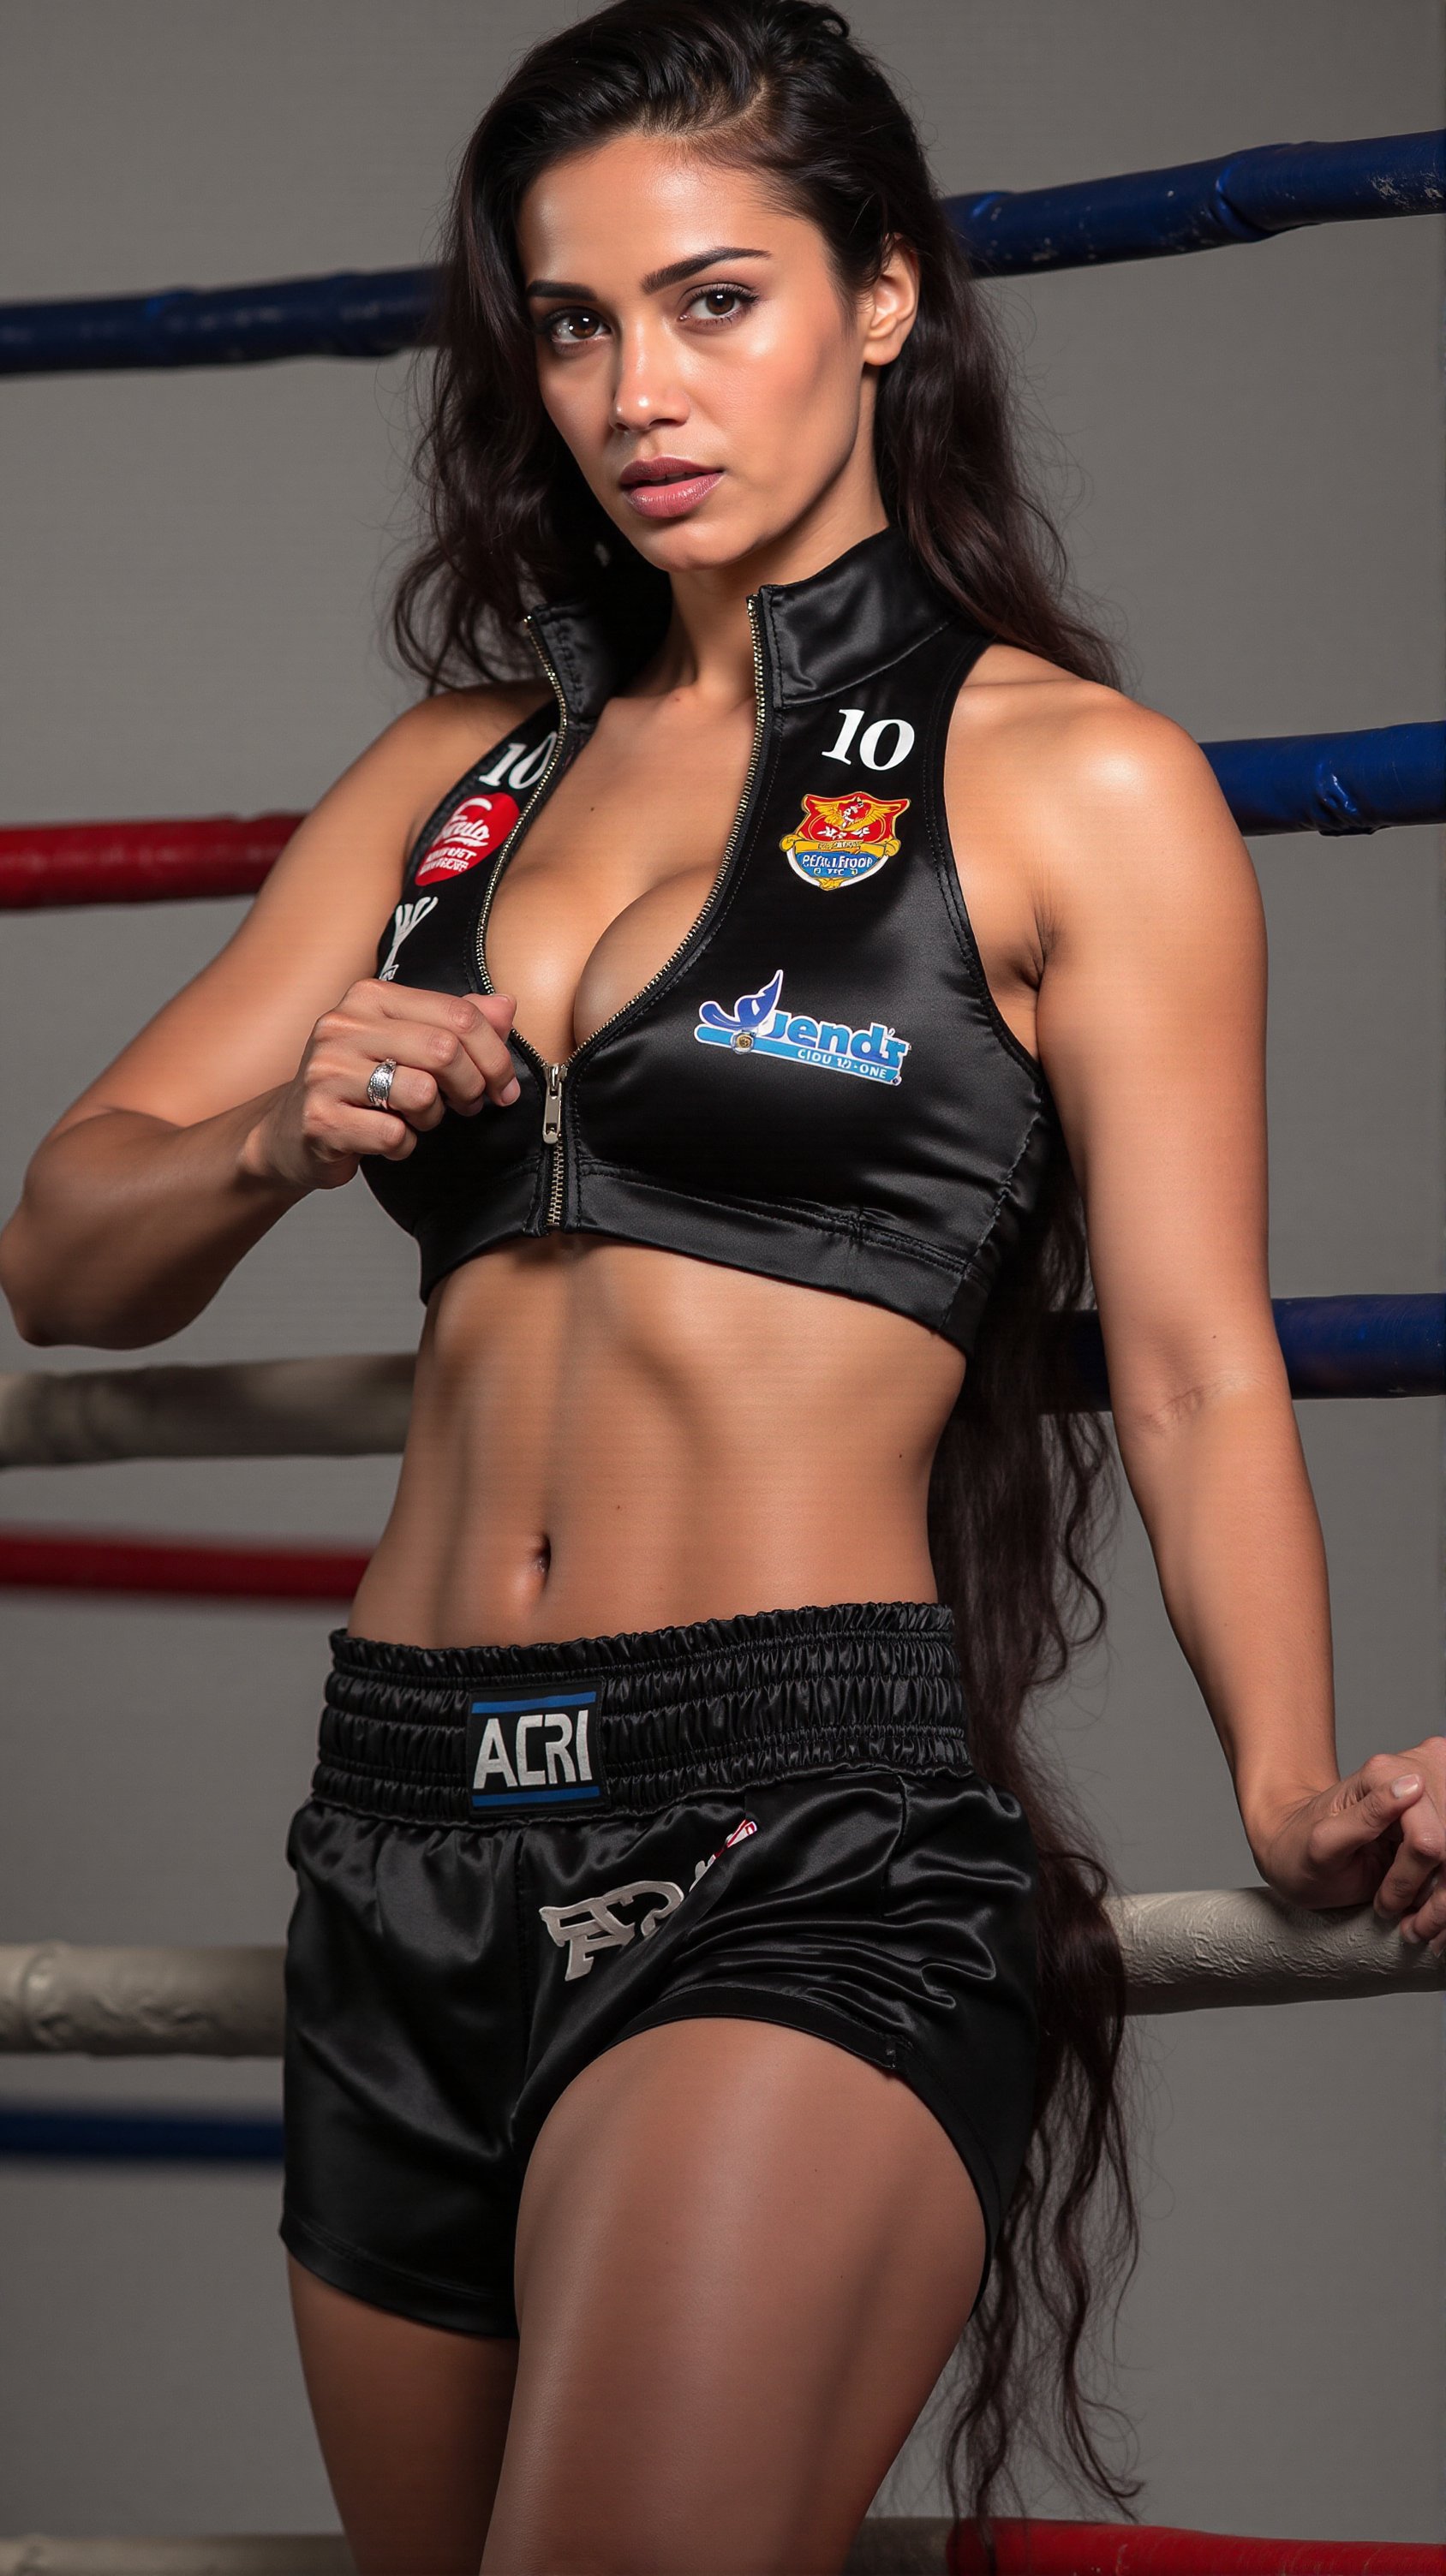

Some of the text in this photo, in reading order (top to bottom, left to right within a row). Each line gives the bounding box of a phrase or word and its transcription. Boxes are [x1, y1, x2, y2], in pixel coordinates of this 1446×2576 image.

[479, 730, 557, 790] 10
[821, 708, 915, 771] 10
[474, 1709, 593, 1789] ACRI
